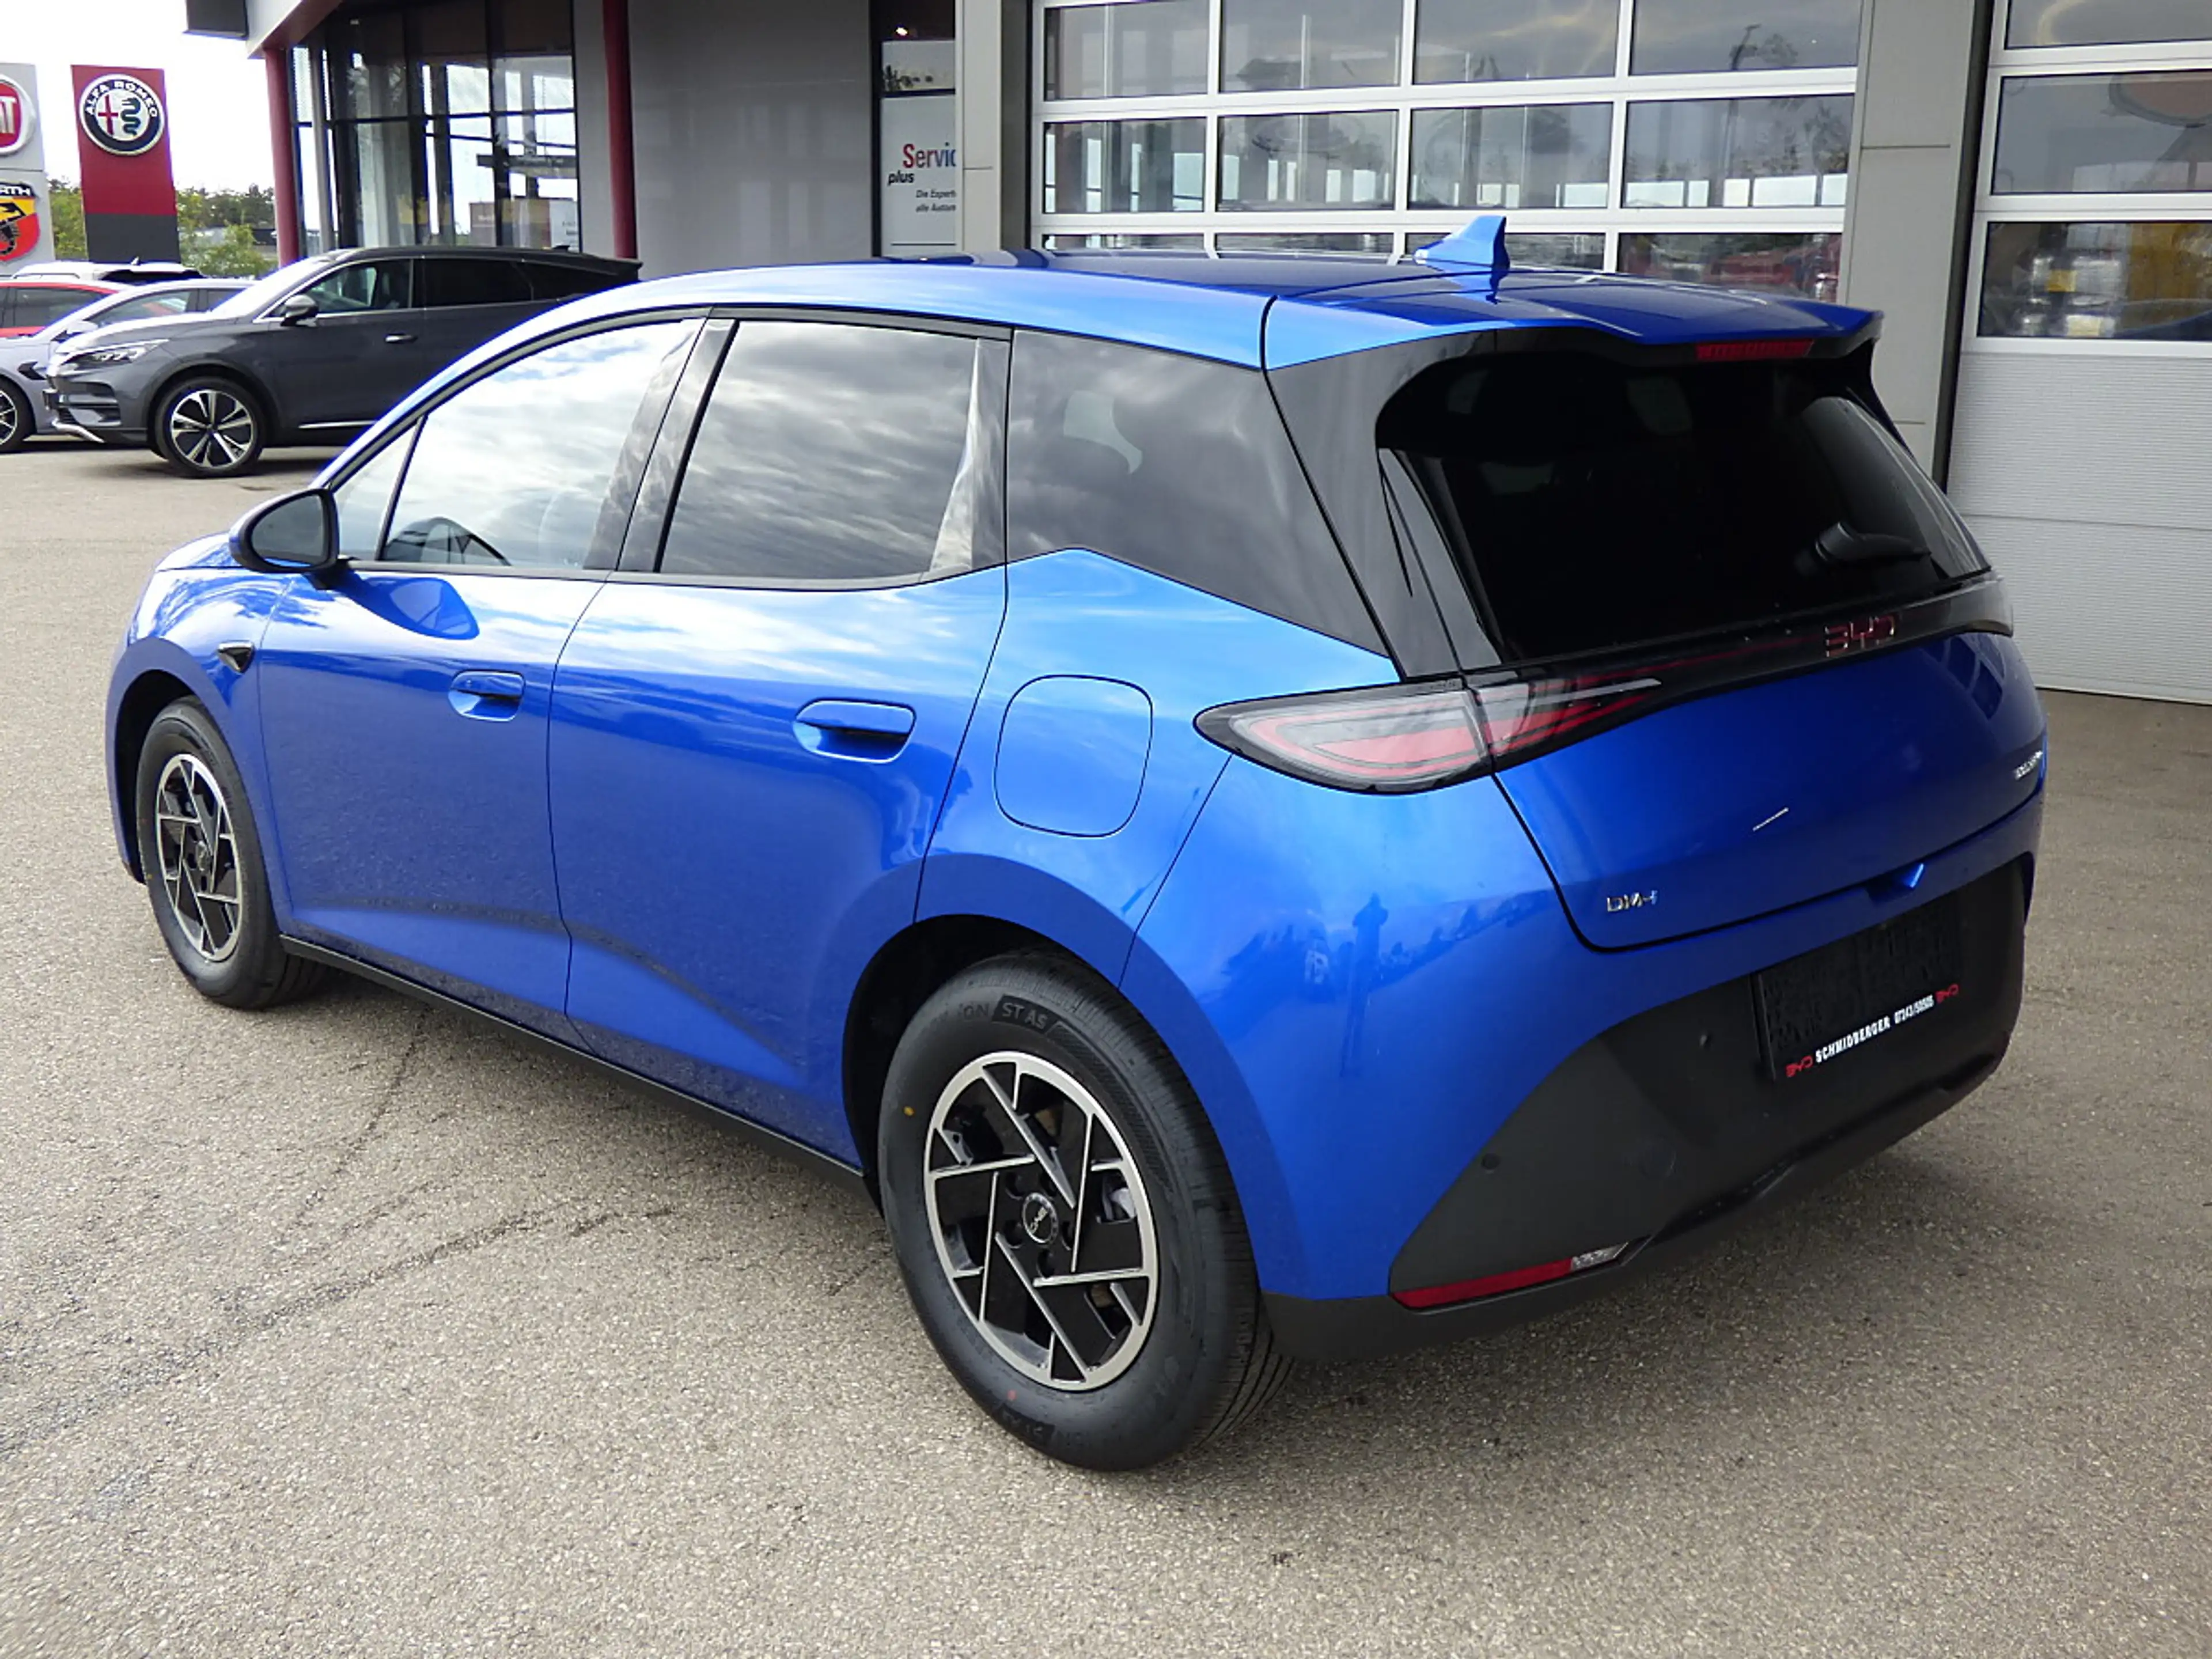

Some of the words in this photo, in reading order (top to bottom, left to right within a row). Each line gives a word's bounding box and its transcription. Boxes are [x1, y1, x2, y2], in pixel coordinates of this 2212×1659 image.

[85, 85, 109, 115] ALFA
[114, 81, 158, 117] ROMEO
[887, 170, 915, 186] plus
[1824, 615, 1895, 658] BYD
[1002, 1002, 1024, 1019] ST
[1024, 1009, 1048, 1029] AS
